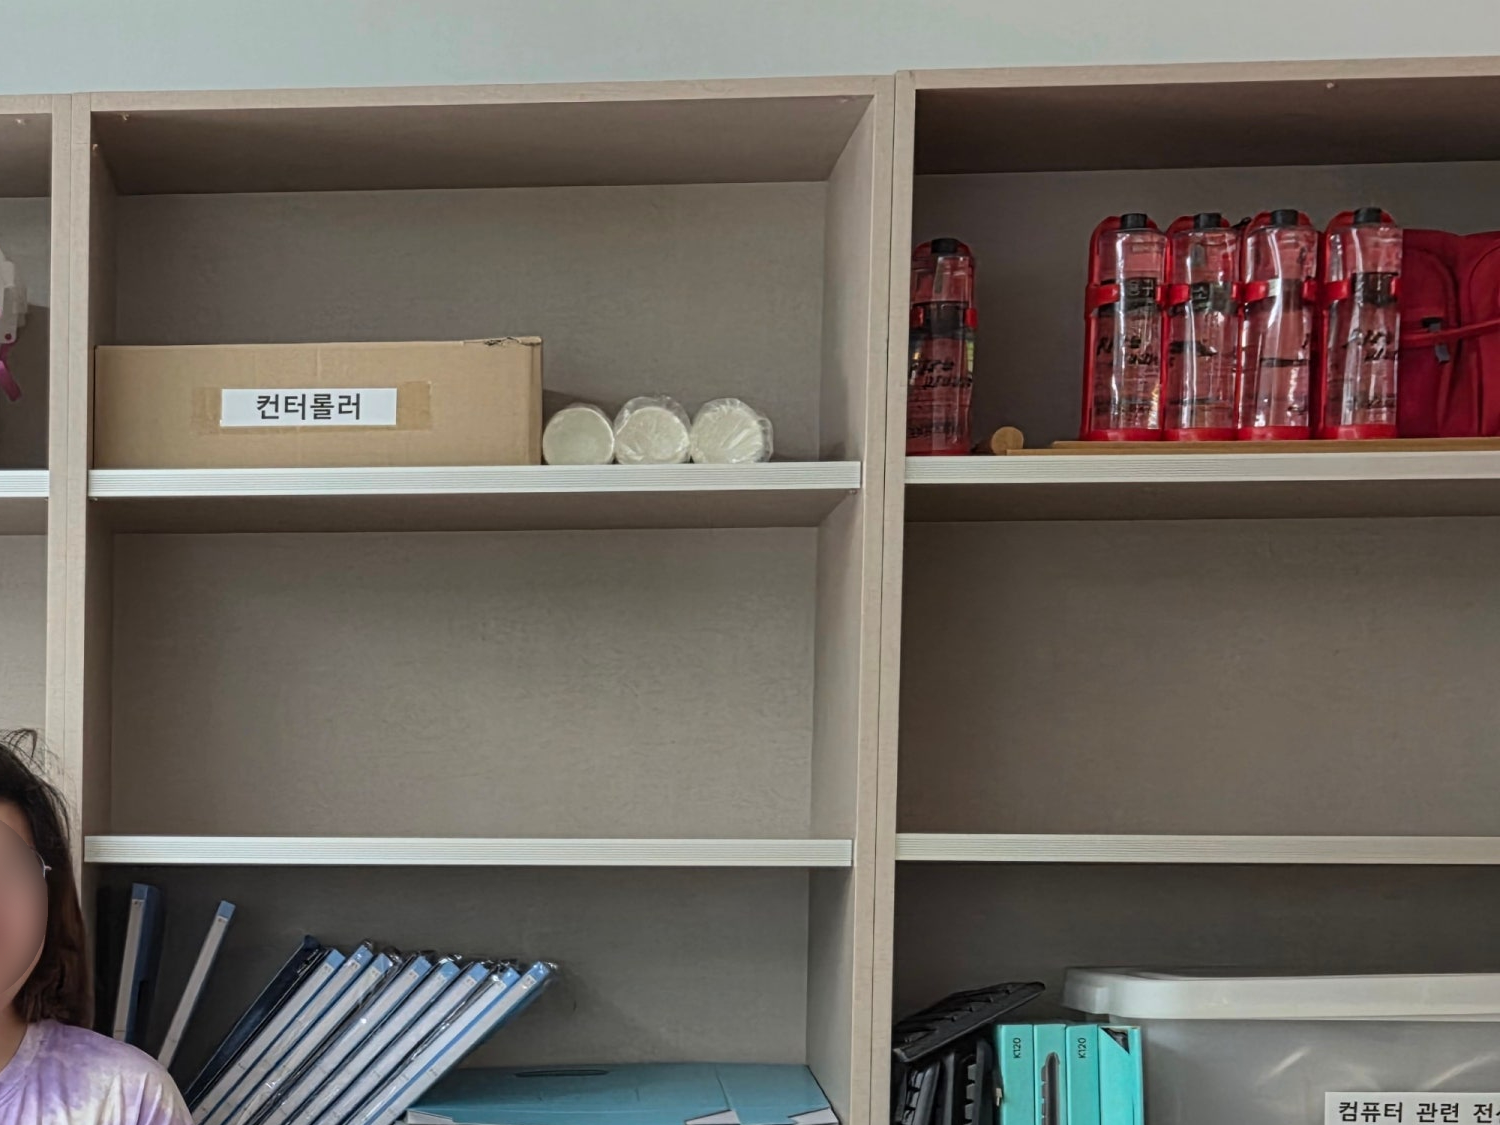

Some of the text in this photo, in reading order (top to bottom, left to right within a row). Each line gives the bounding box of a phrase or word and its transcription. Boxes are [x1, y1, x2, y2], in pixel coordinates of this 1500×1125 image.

[256, 393, 361, 421] 컨터롤러
[1013, 1037, 1021, 1058] K120
[1078, 1037, 1087, 1058] K120
[1338, 1101, 1403, 1123] 컴퓨터
[1416, 1102, 1459, 1123] 관련
